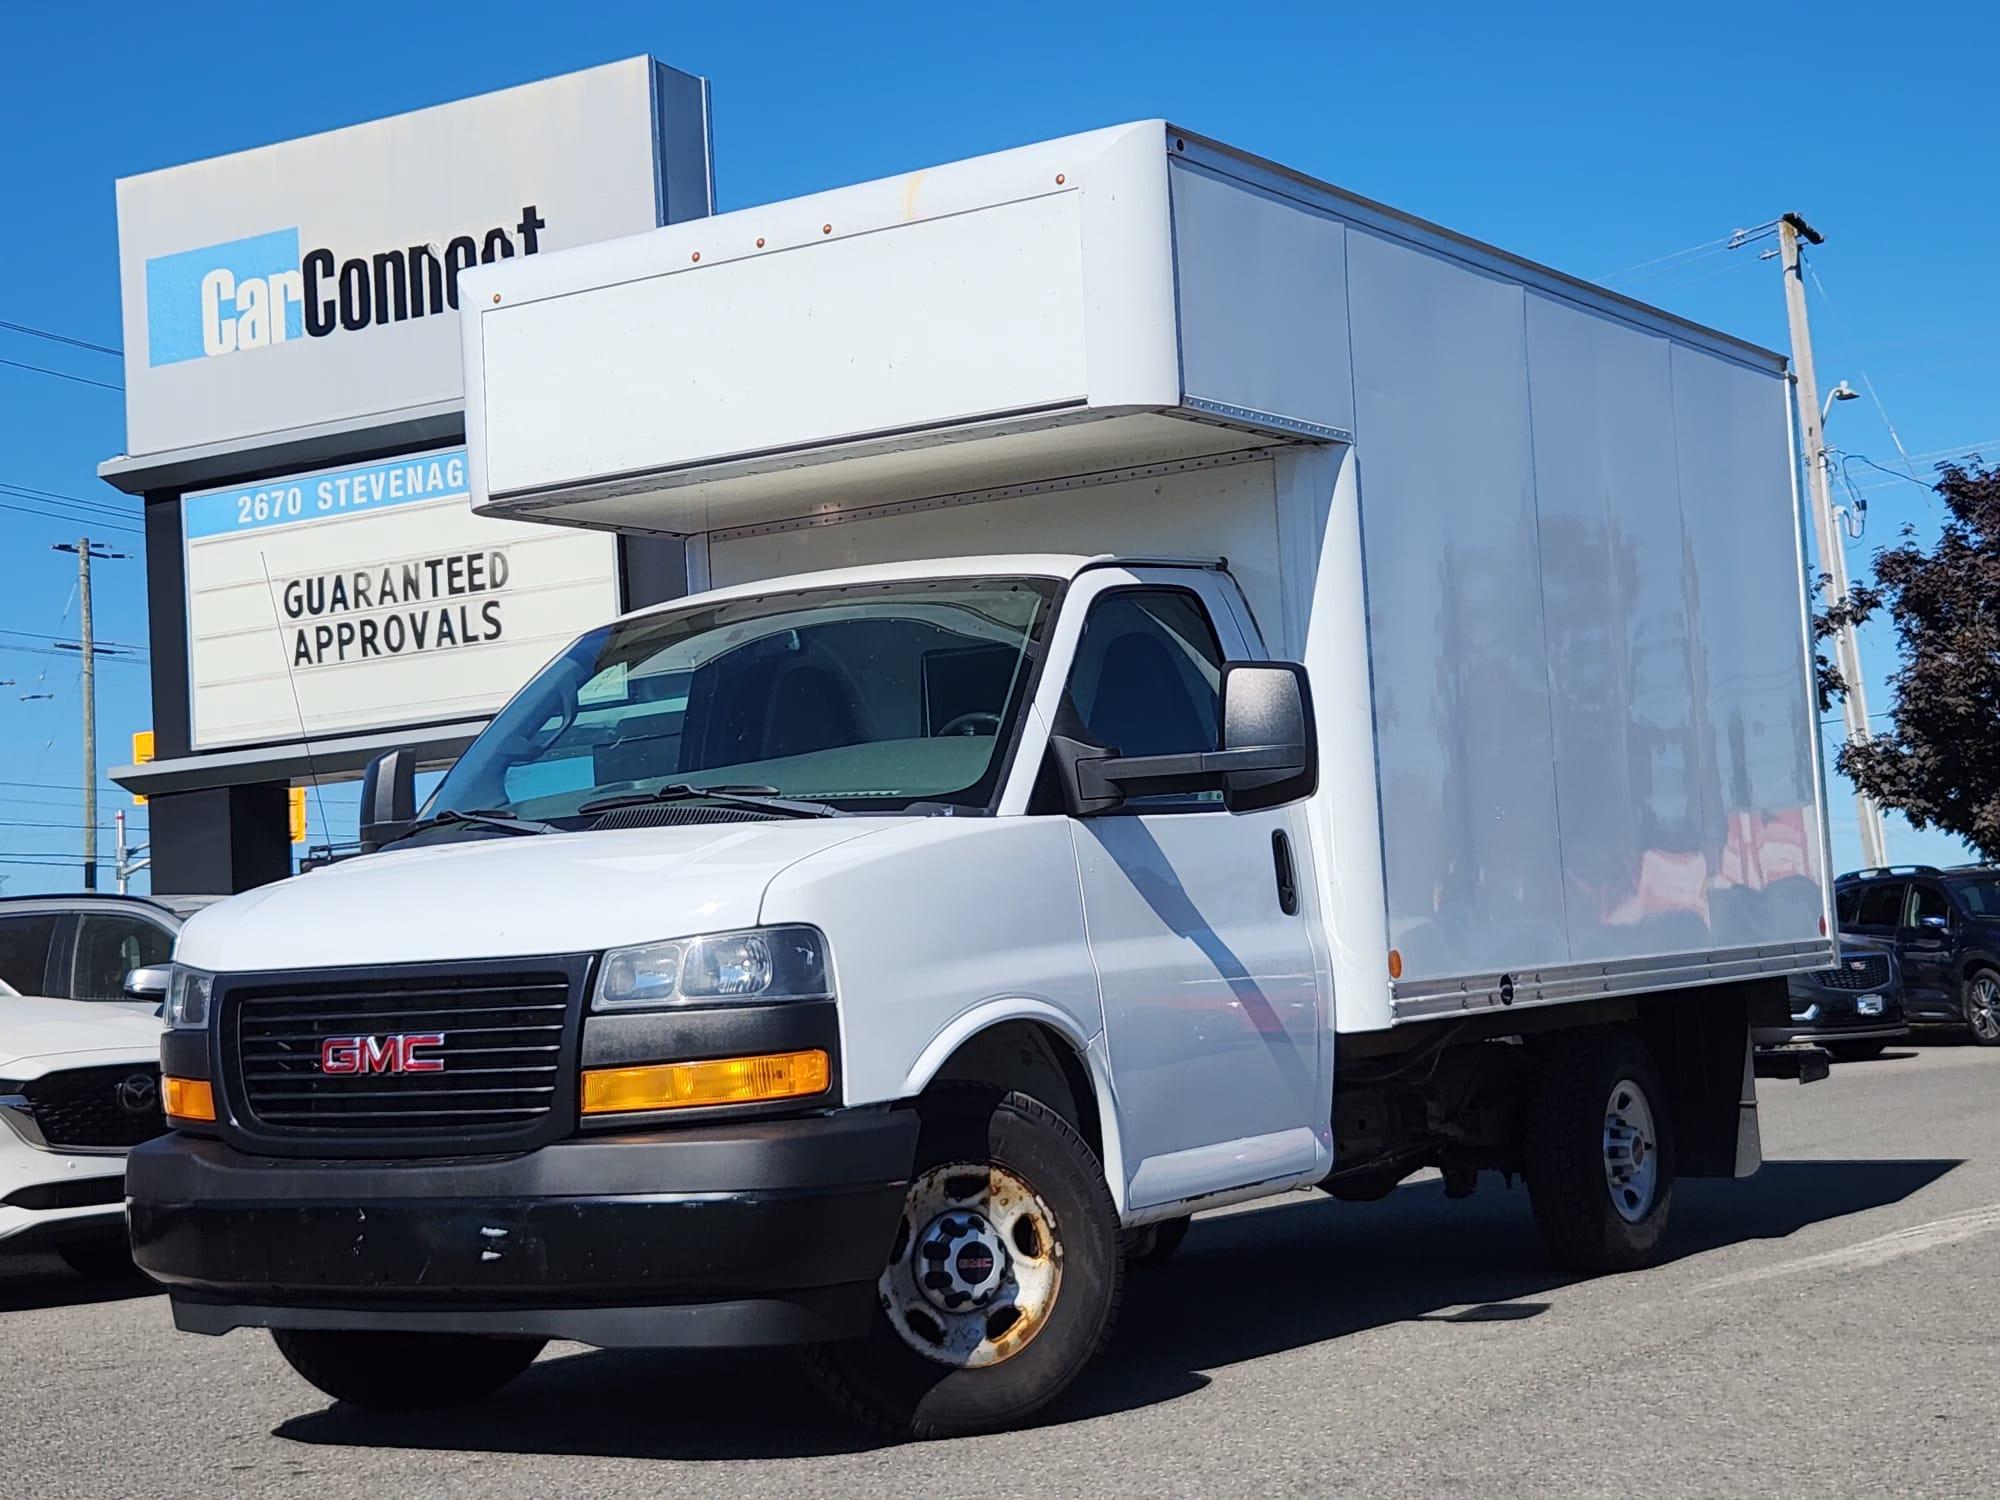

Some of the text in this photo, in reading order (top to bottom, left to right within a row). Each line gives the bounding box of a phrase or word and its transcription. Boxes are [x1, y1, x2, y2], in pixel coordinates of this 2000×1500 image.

[238, 458, 464, 524] 2670 STEVENAG
[284, 551, 509, 618] GUARANTEED
[294, 600, 502, 667] APPROVALS
[322, 1032, 445, 1074] GMC
